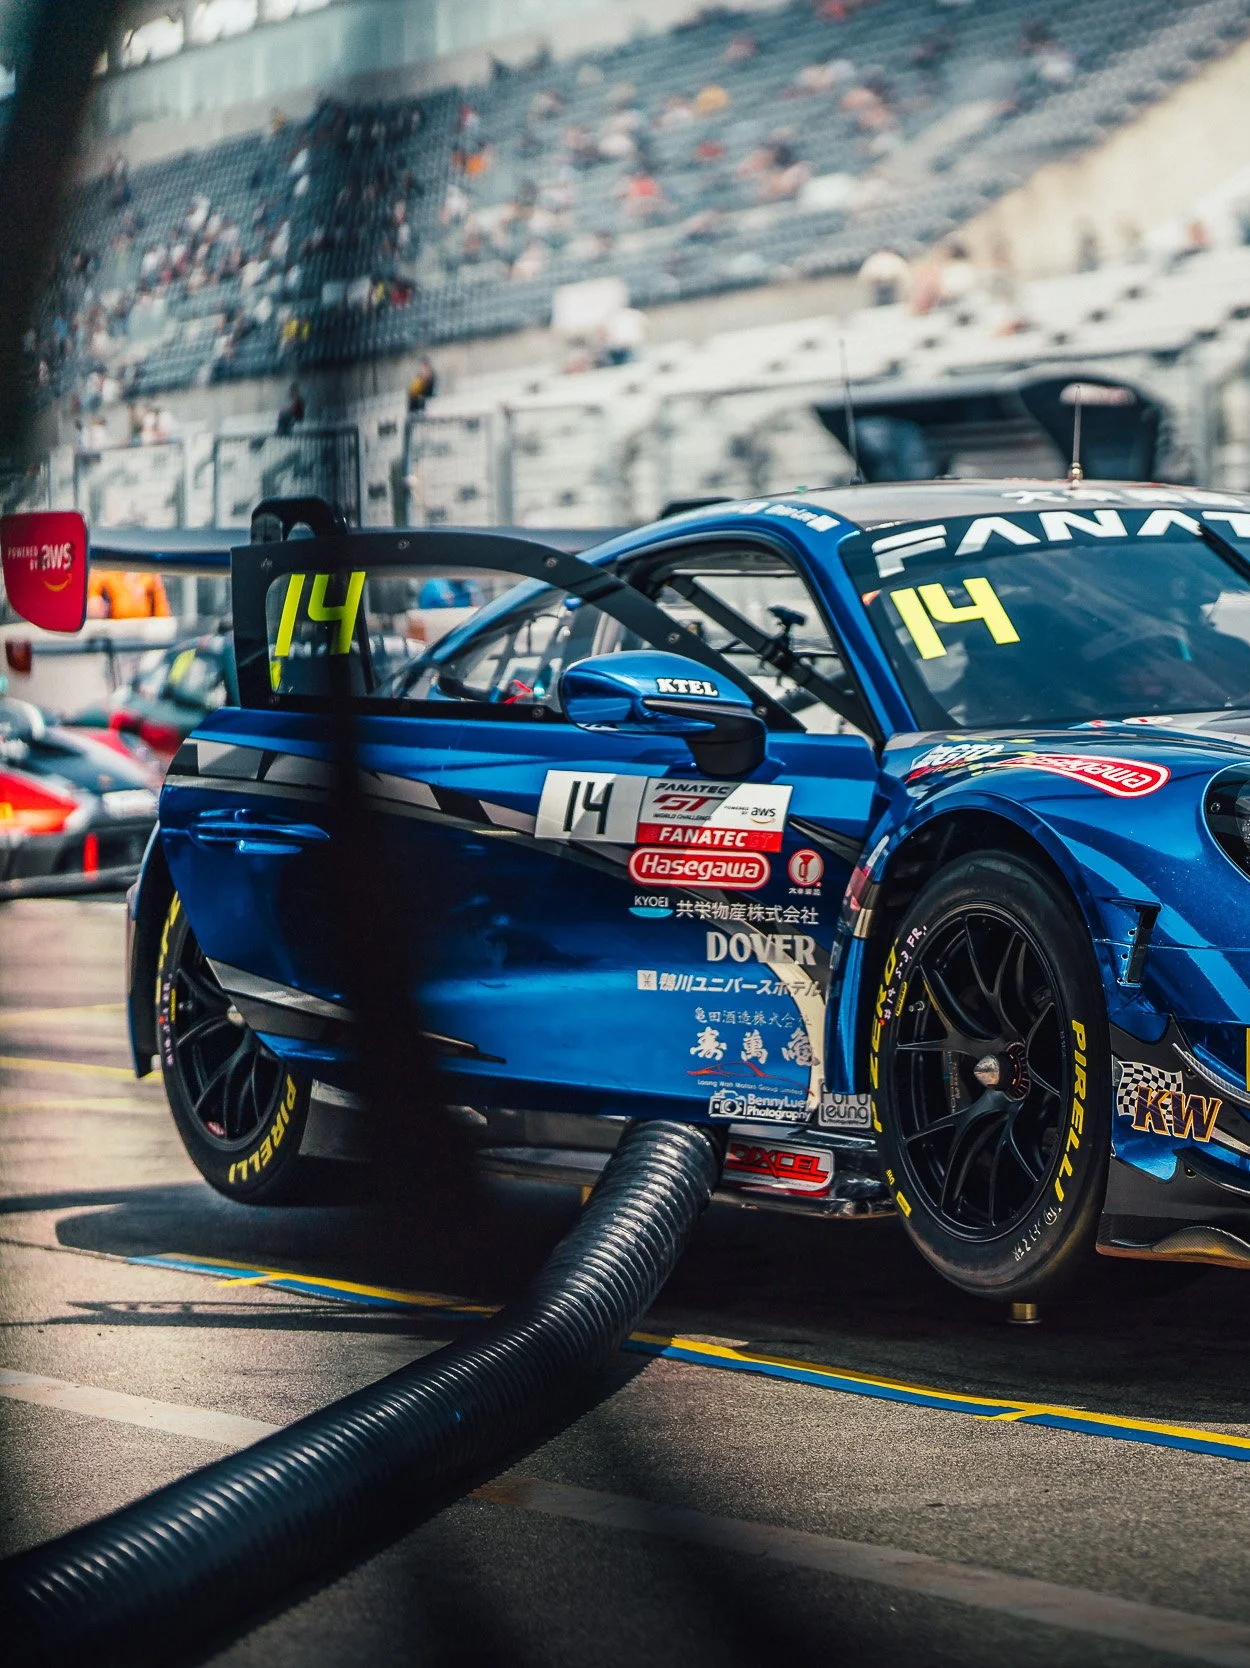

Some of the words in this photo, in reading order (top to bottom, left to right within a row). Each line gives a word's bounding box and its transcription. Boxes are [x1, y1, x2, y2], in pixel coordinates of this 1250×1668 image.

[42, 542, 72, 571] aws
[274, 571, 367, 657] 14
[890, 577, 1021, 660] 14
[656, 678, 719, 697] KTEL
[655, 783, 730, 794] FANATEC
[563, 781, 614, 835] 14
[751, 807, 776, 817] aws
[659, 827, 748, 847] FANATEC
[640, 854, 760, 881] Hasegawa
[634, 895, 668, 908] KYOEI
[676, 899, 819, 925] 共栄物産株式会社
[706, 931, 817, 966] DOVER
[1055, 1019, 1087, 1202] PIRELLI
[1132, 1085, 1223, 1142] KW
[228, 1073, 297, 1185] PIRELLI
[727, 1143, 829, 1178] DIXCEL
